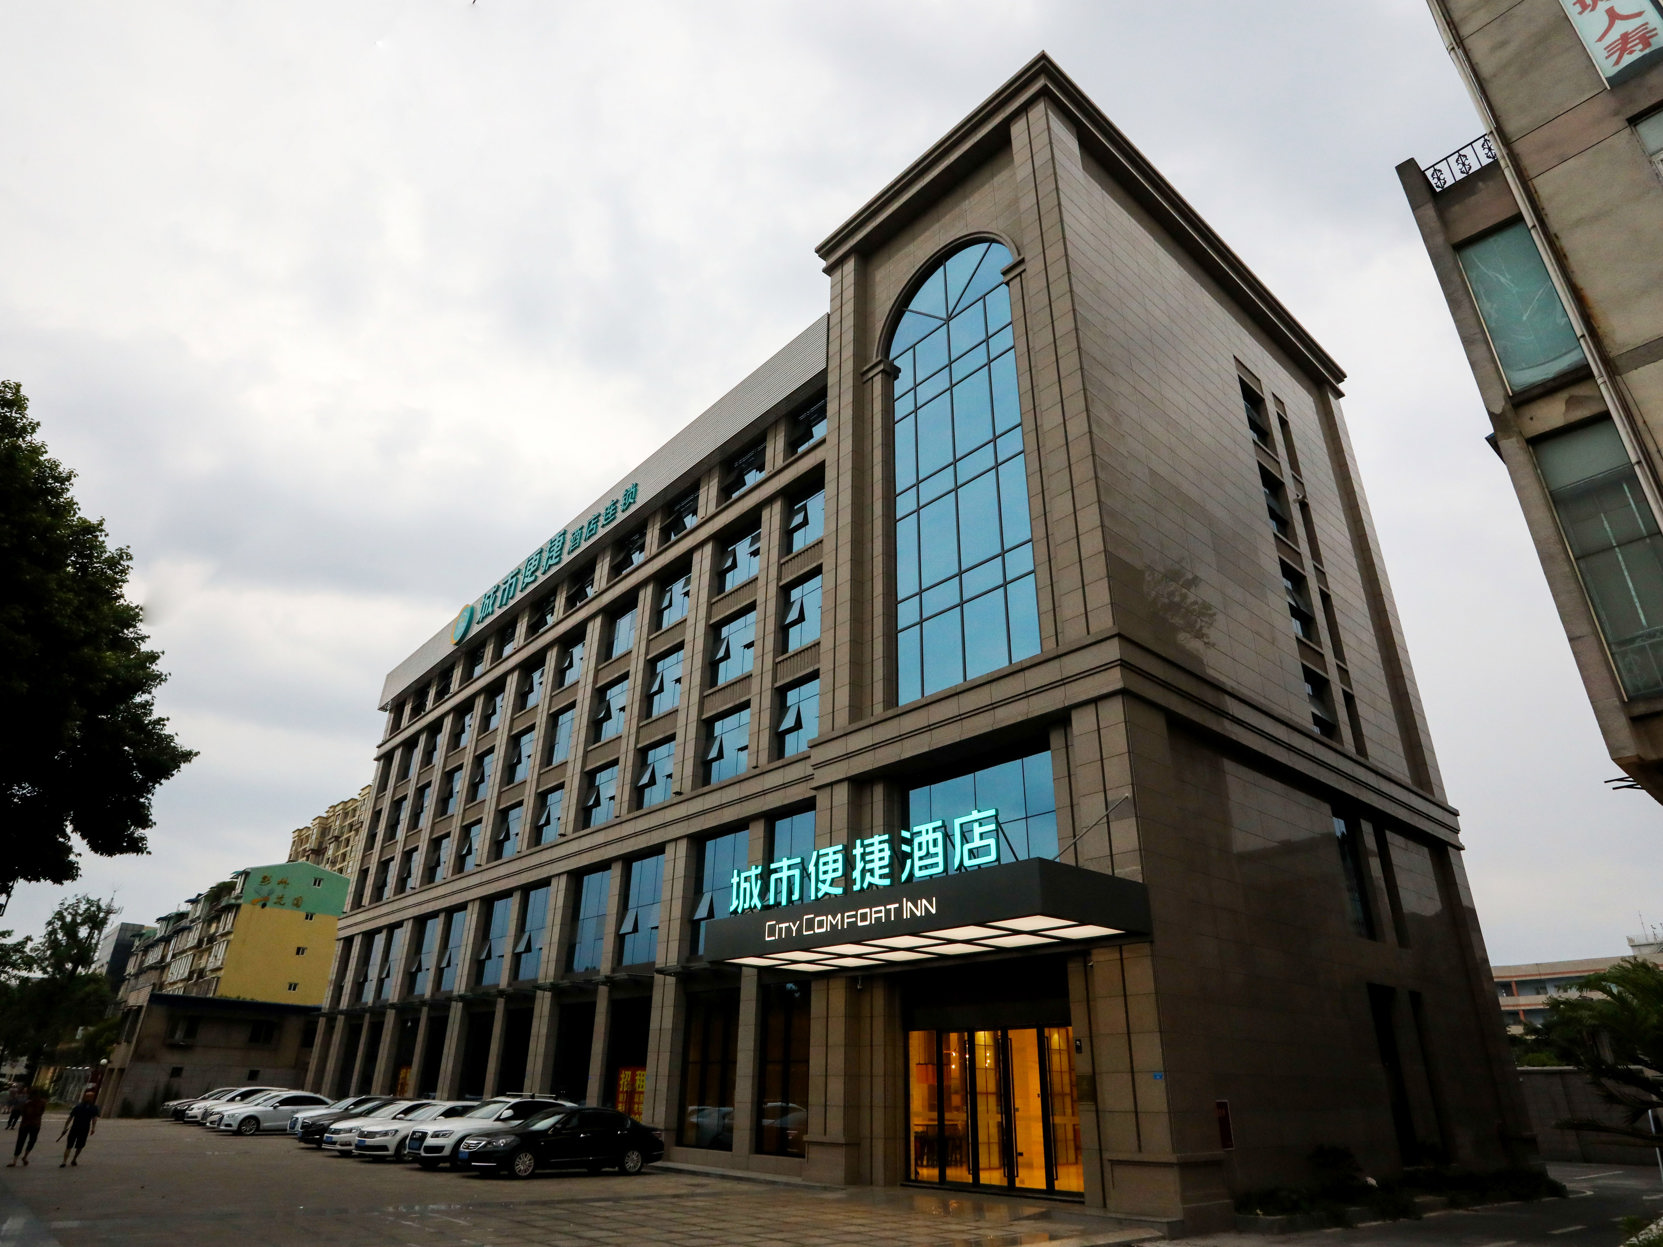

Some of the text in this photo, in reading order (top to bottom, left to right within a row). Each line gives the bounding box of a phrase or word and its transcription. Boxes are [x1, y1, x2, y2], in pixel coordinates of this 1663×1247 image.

[729, 808, 999, 914] 城市便捷酒店
[765, 897, 936, 941] CITY COMFORT INN
